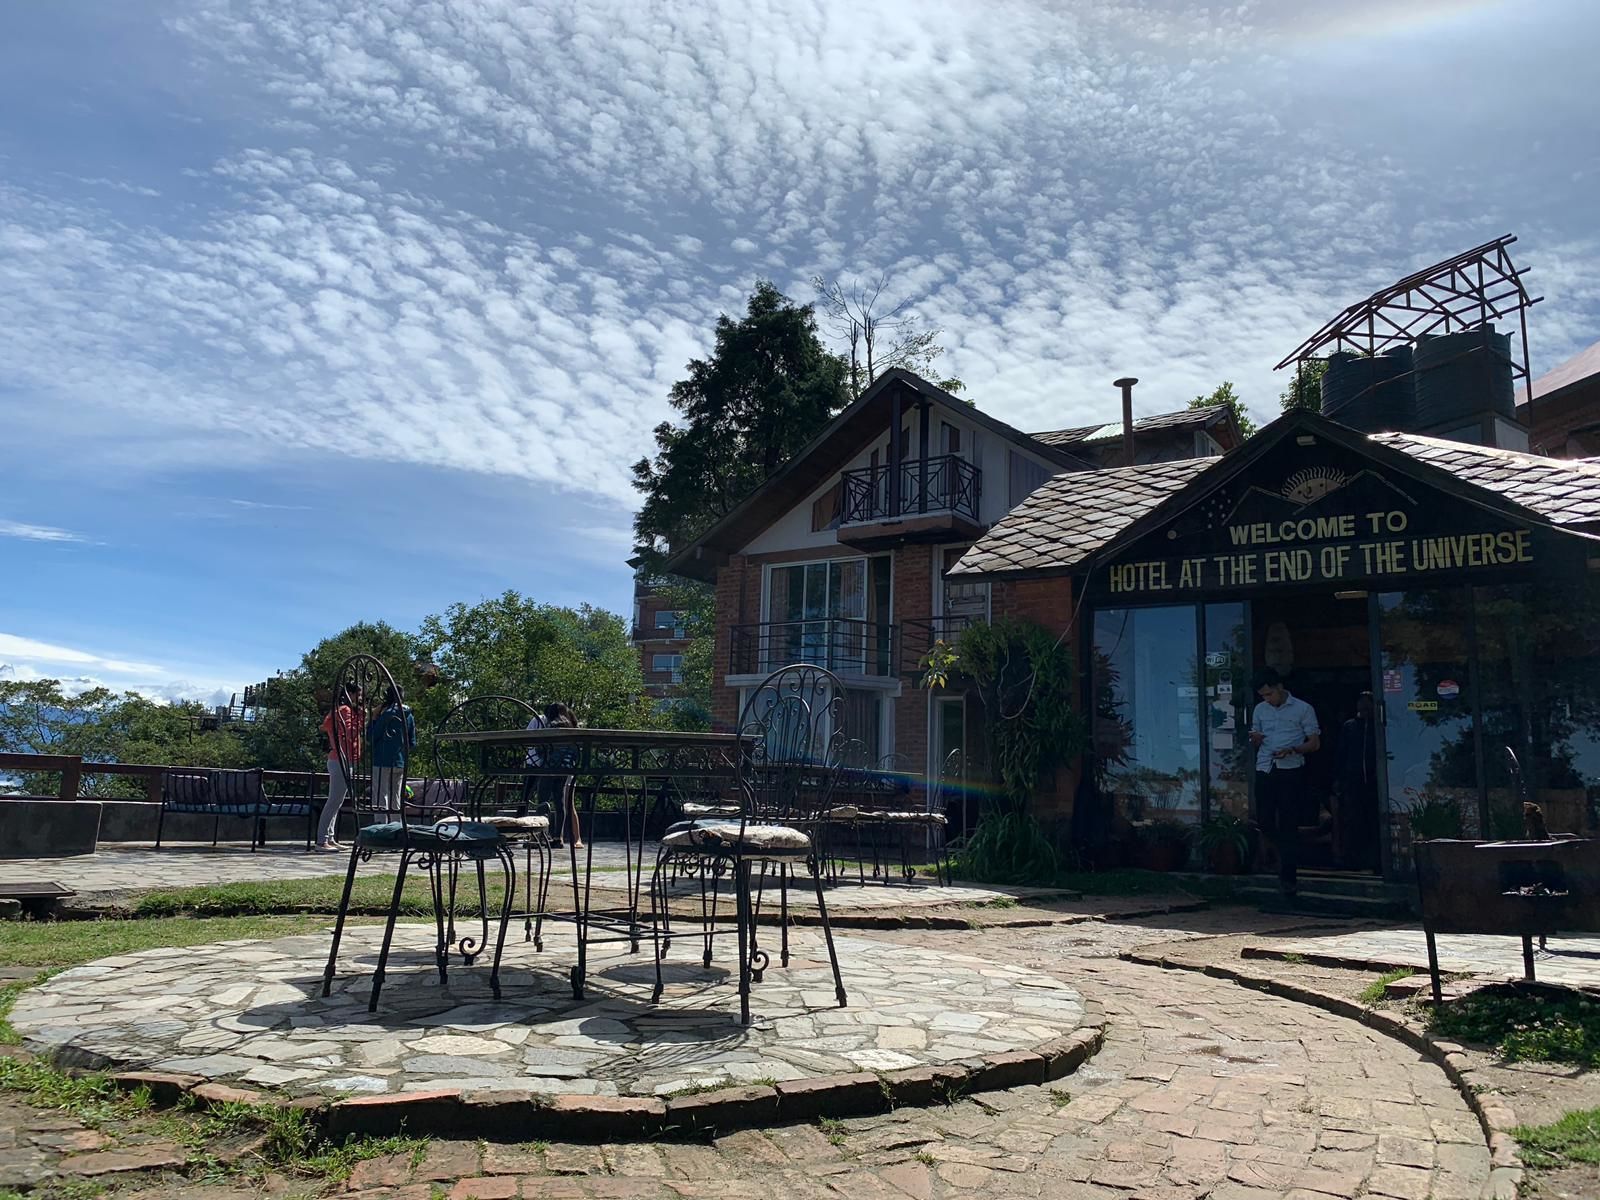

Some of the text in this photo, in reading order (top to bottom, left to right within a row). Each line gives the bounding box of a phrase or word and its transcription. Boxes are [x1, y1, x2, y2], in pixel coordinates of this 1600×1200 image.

[1229, 511, 1407, 545] WELCOME TO
[1110, 530, 1533, 592] HOTEL AT THE END OF THE UNIVERSE
